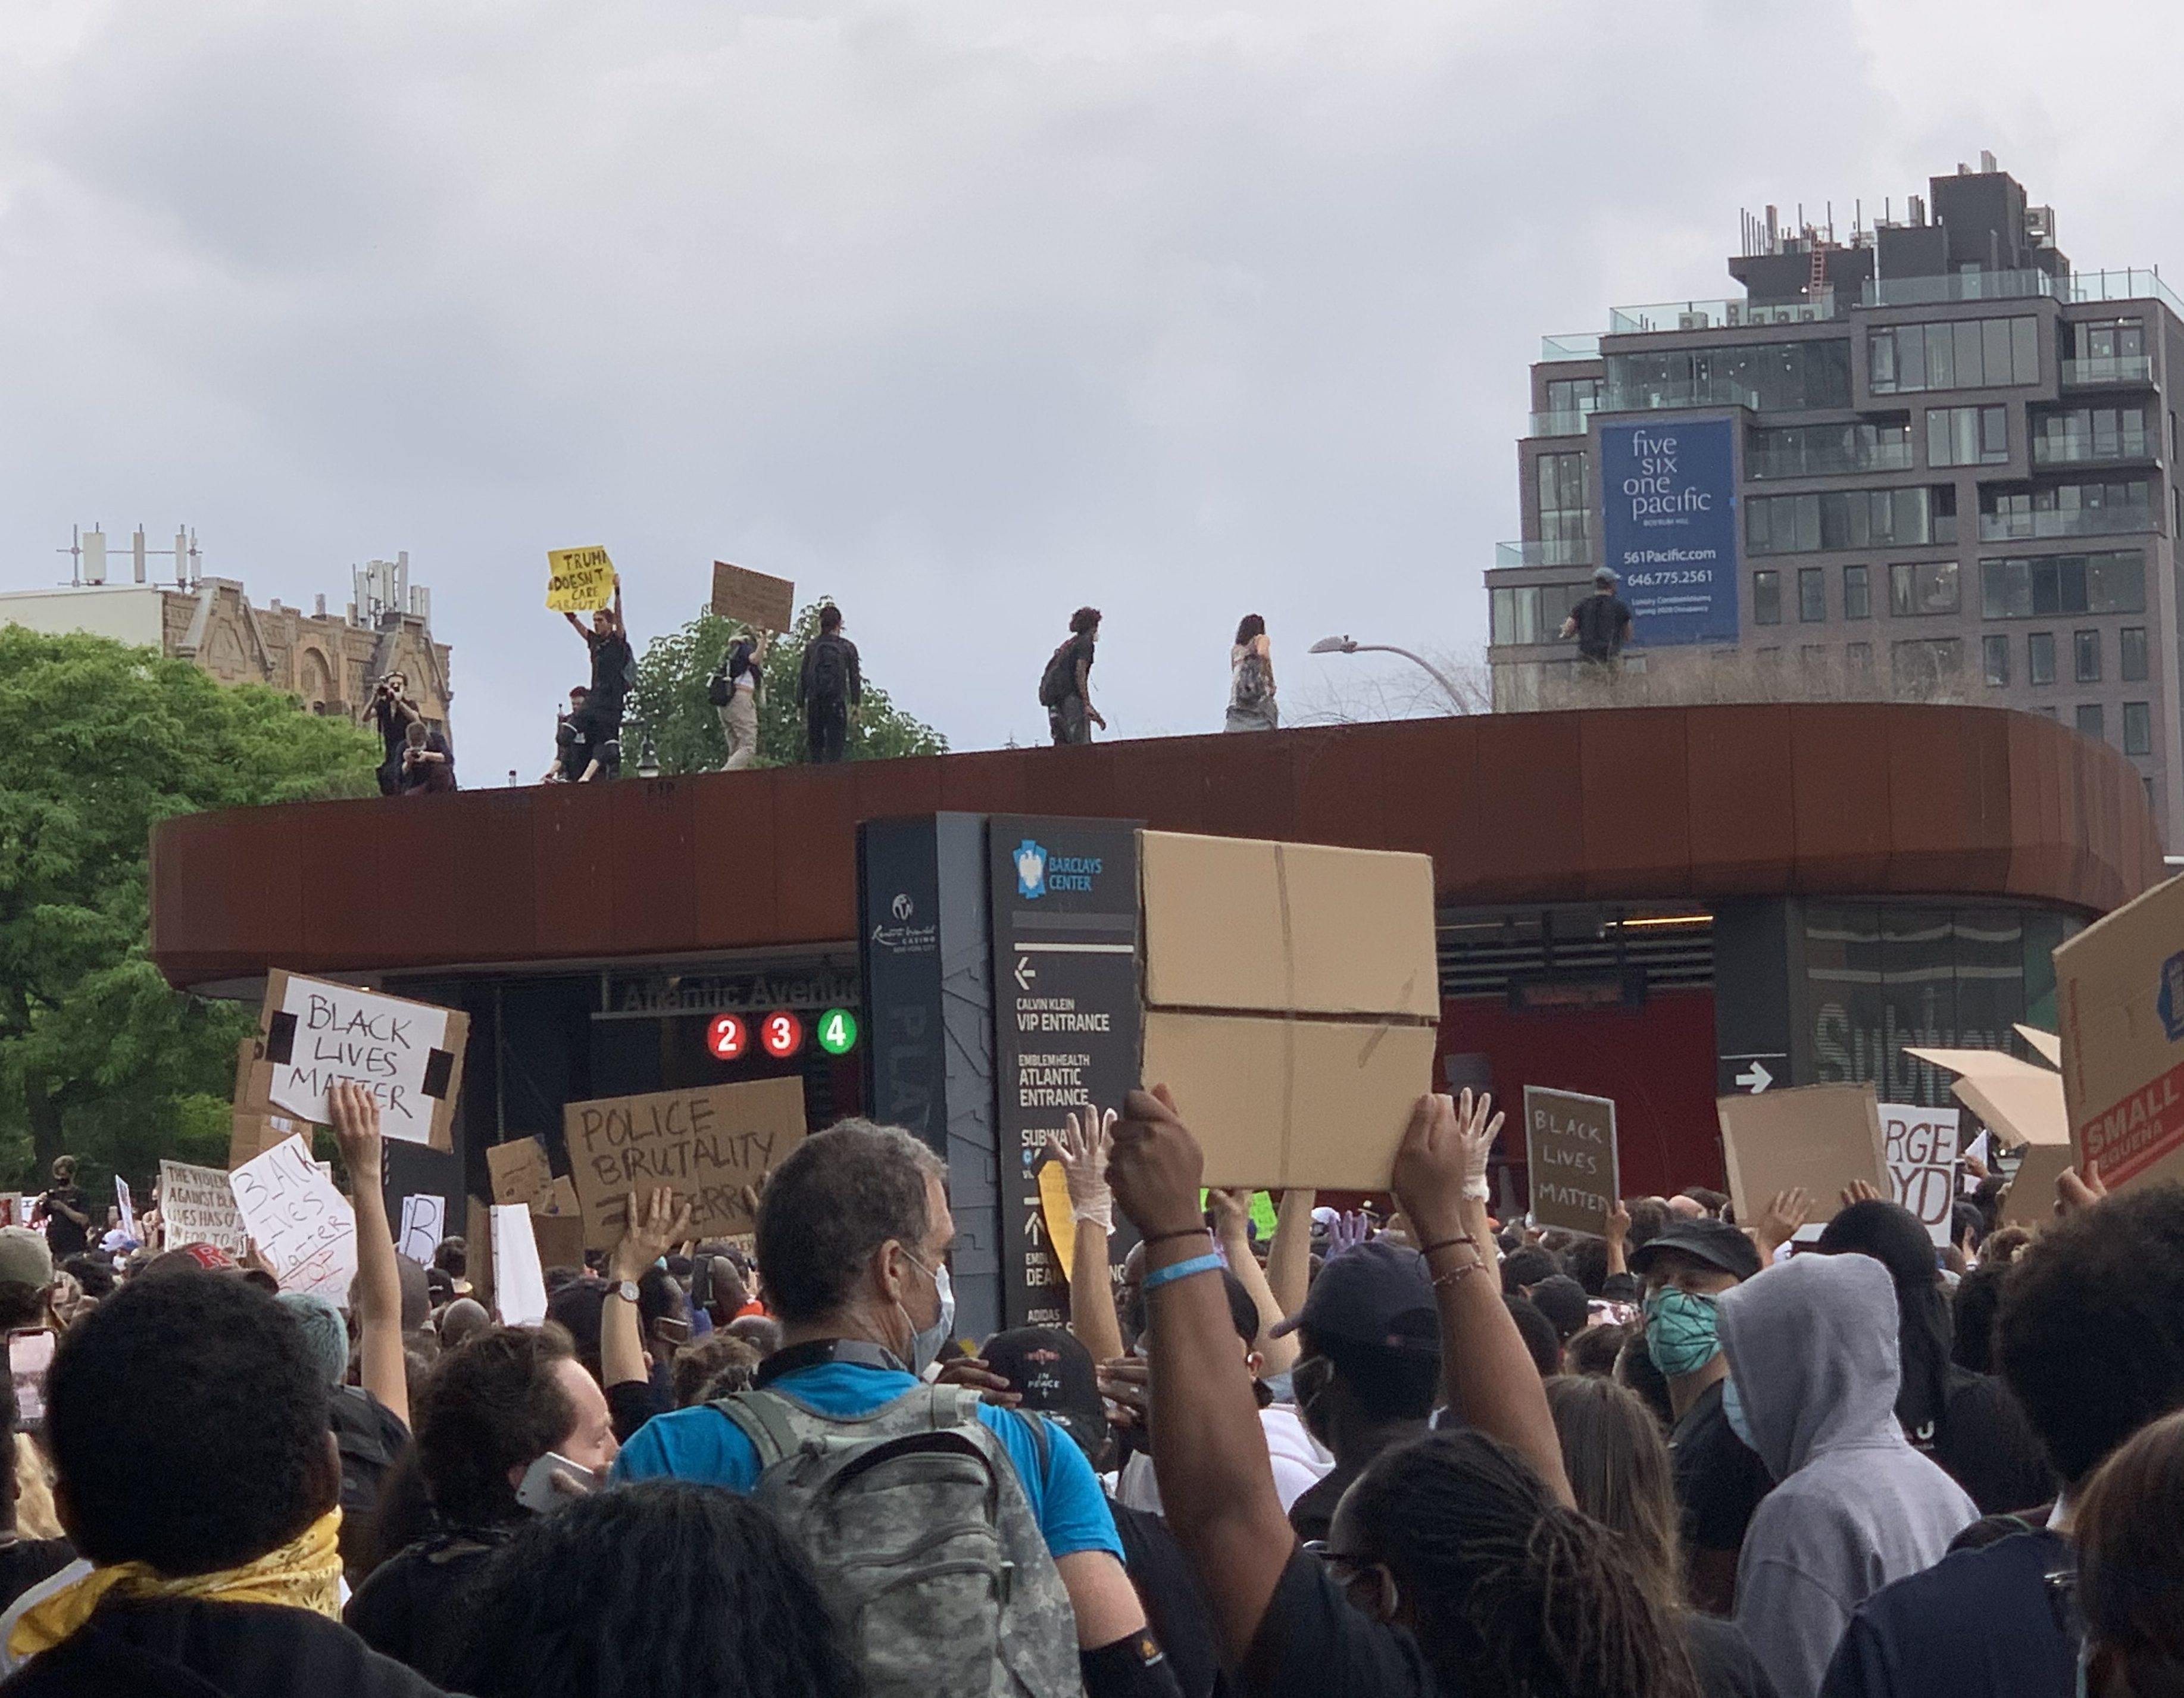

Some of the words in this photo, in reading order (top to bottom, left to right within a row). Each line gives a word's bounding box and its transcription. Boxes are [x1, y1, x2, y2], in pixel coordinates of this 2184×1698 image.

[1632, 430, 1677, 457] five
[1641, 457, 1678, 475] six
[1623, 476, 1671, 495] one
[1632, 486, 1711, 521] pacific
[1623, 548, 1717, 564] 561Pacific.com
[1627, 570, 1713, 586] 646.775.2561
[571, 586, 599, 601] CARE
[1048, 857, 1102, 875] BARCLAYS
[1049, 874, 1092, 891] CENTER
[623, 975, 739, 1011] Atlantic
[1016, 998, 1048, 1010] CALVIN
[1049, 998, 1075, 1010] KLEIN
[307, 994, 413, 1049] BLACK
[1017, 1013, 1039, 1031] VIP
[1042, 1013, 1110, 1032] ENTRANCE
[717, 1020, 736, 1051] 2
[771, 1017, 791, 1050] 3
[826, 1015, 846, 1047] 4
[314, 1037, 398, 1077] LIVES
[1019, 1068, 1082, 1086] ATLANTIC
[289, 1067, 414, 1119] MATTER
[1020, 1088, 1089, 1107] ENTRANCE
[581, 1098, 715, 1153] POLICE
[2087, 1076, 2180, 1155] SMALL
[1534, 1110, 1602, 1144] BLACK
[1021, 1128, 1070, 1147] SUBWA
[591, 1132, 774, 1186] BRUTALITY
[1544, 1144, 1596, 1175] LIVES
[168, 1187, 214, 1207] AGAINST
[1539, 1182, 1611, 1215] MATTER
[1889, 1165, 1952, 1226] YD
[1027, 1308, 1060, 1322] ADIDAS
[1027, 1379, 1060, 1388] PEACE
